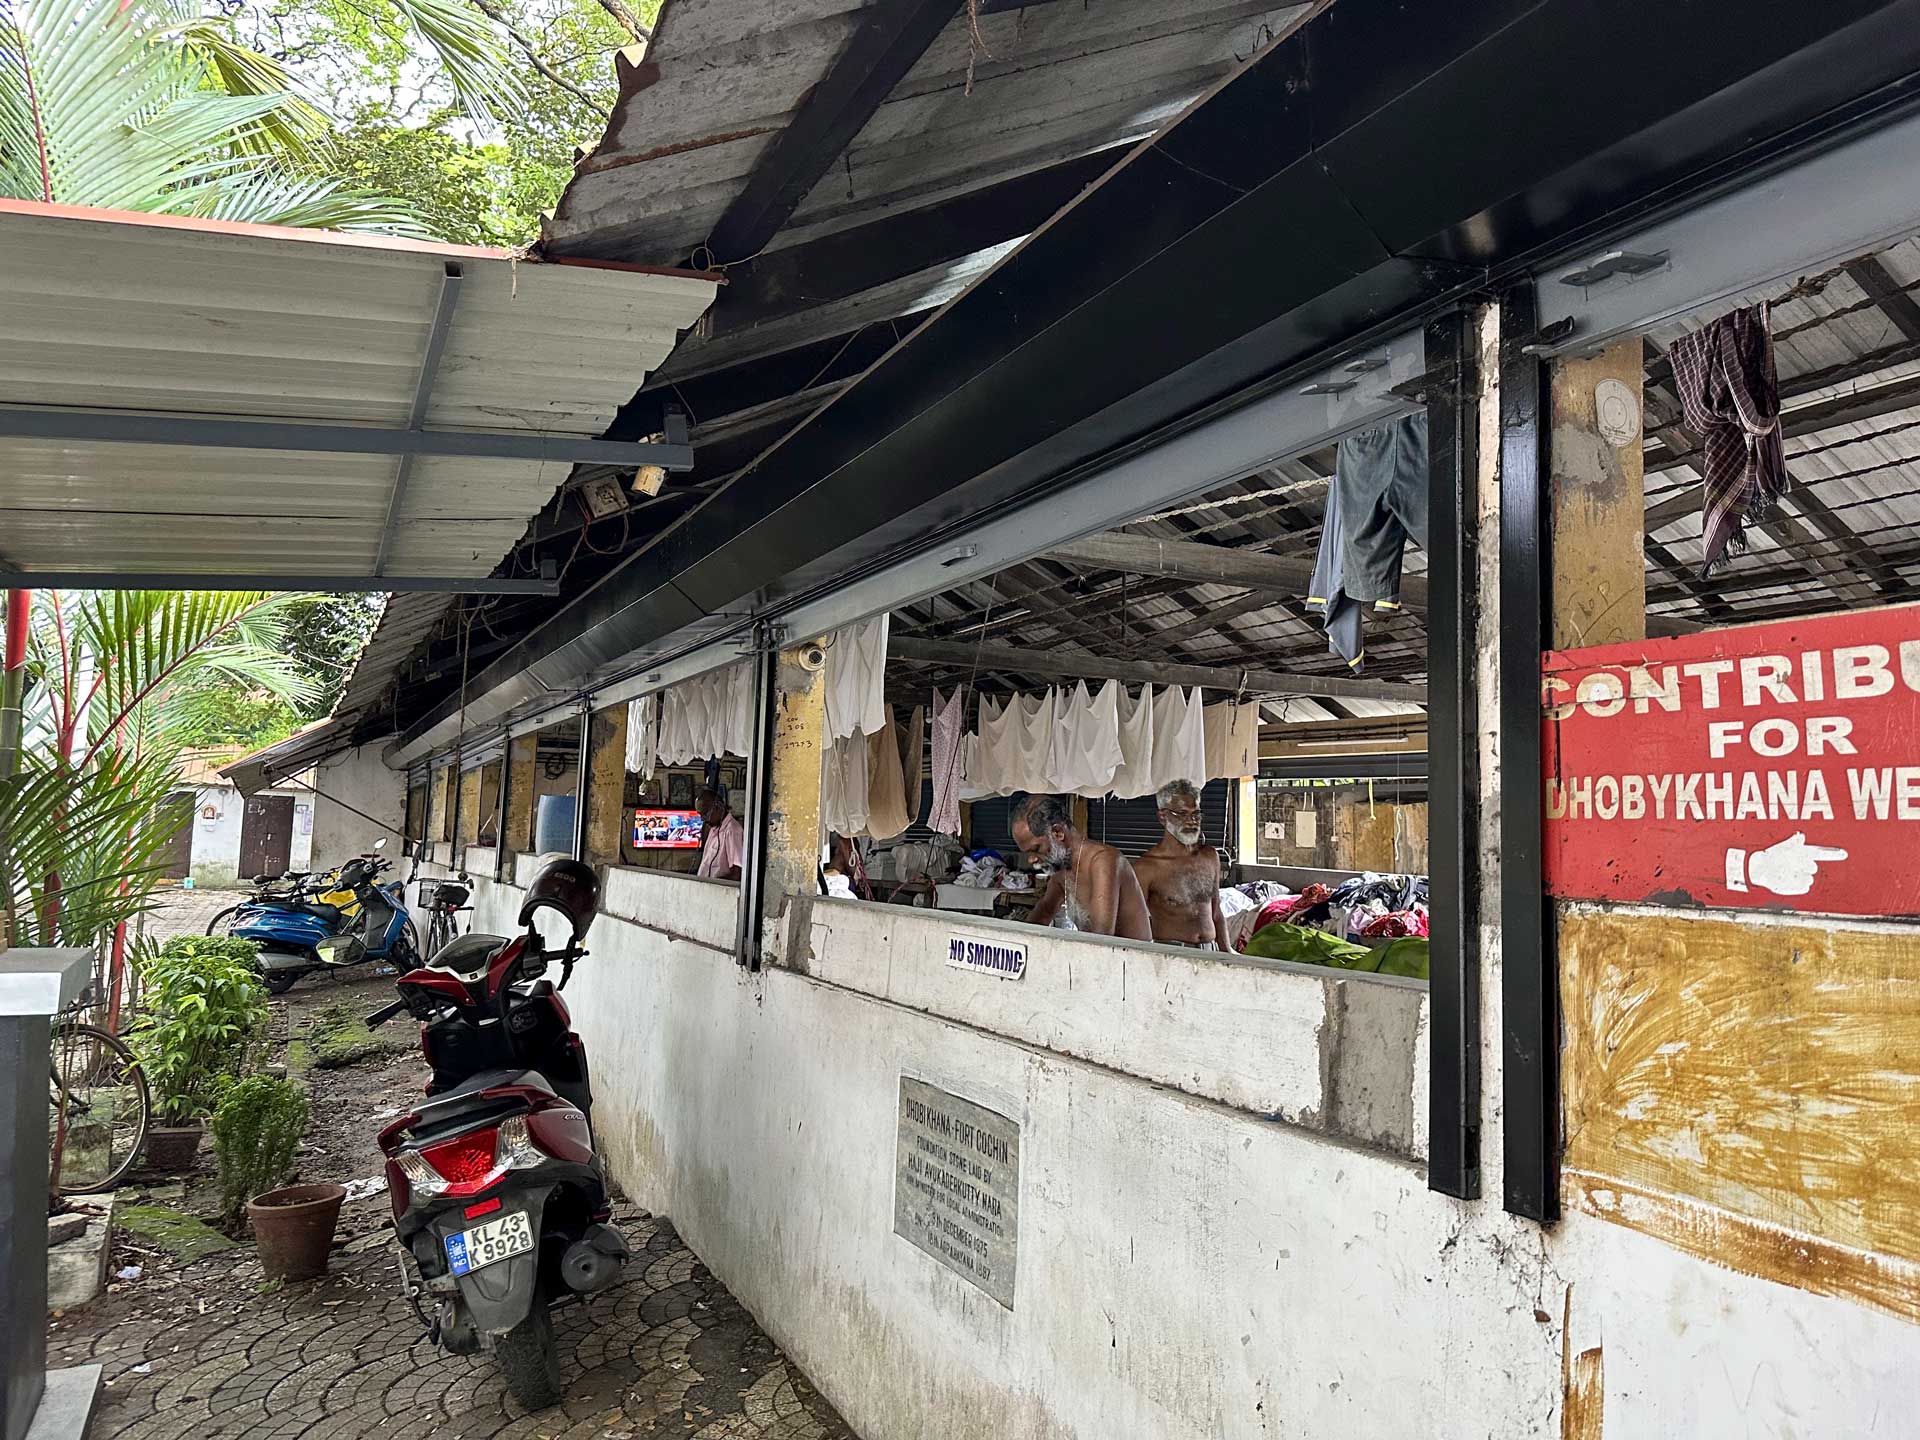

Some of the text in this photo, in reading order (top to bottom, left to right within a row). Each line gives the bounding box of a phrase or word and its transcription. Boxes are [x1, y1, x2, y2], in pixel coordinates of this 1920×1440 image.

[1708, 716, 1859, 759] FOR
[1546, 769, 1835, 820] DHOBYKHANA
[949, 938, 1025, 974] NO SMOKING
[908, 1151, 922, 1175] HAJI
[916, 1135, 992, 1185] FOUNDATION STONE LAID BY
[976, 1129, 1008, 1164] COCHIN
[468, 1230, 531, 1267] K 9928
[471, 1215, 521, 1247] KL 43
[453, 1258, 467, 1268] IND
